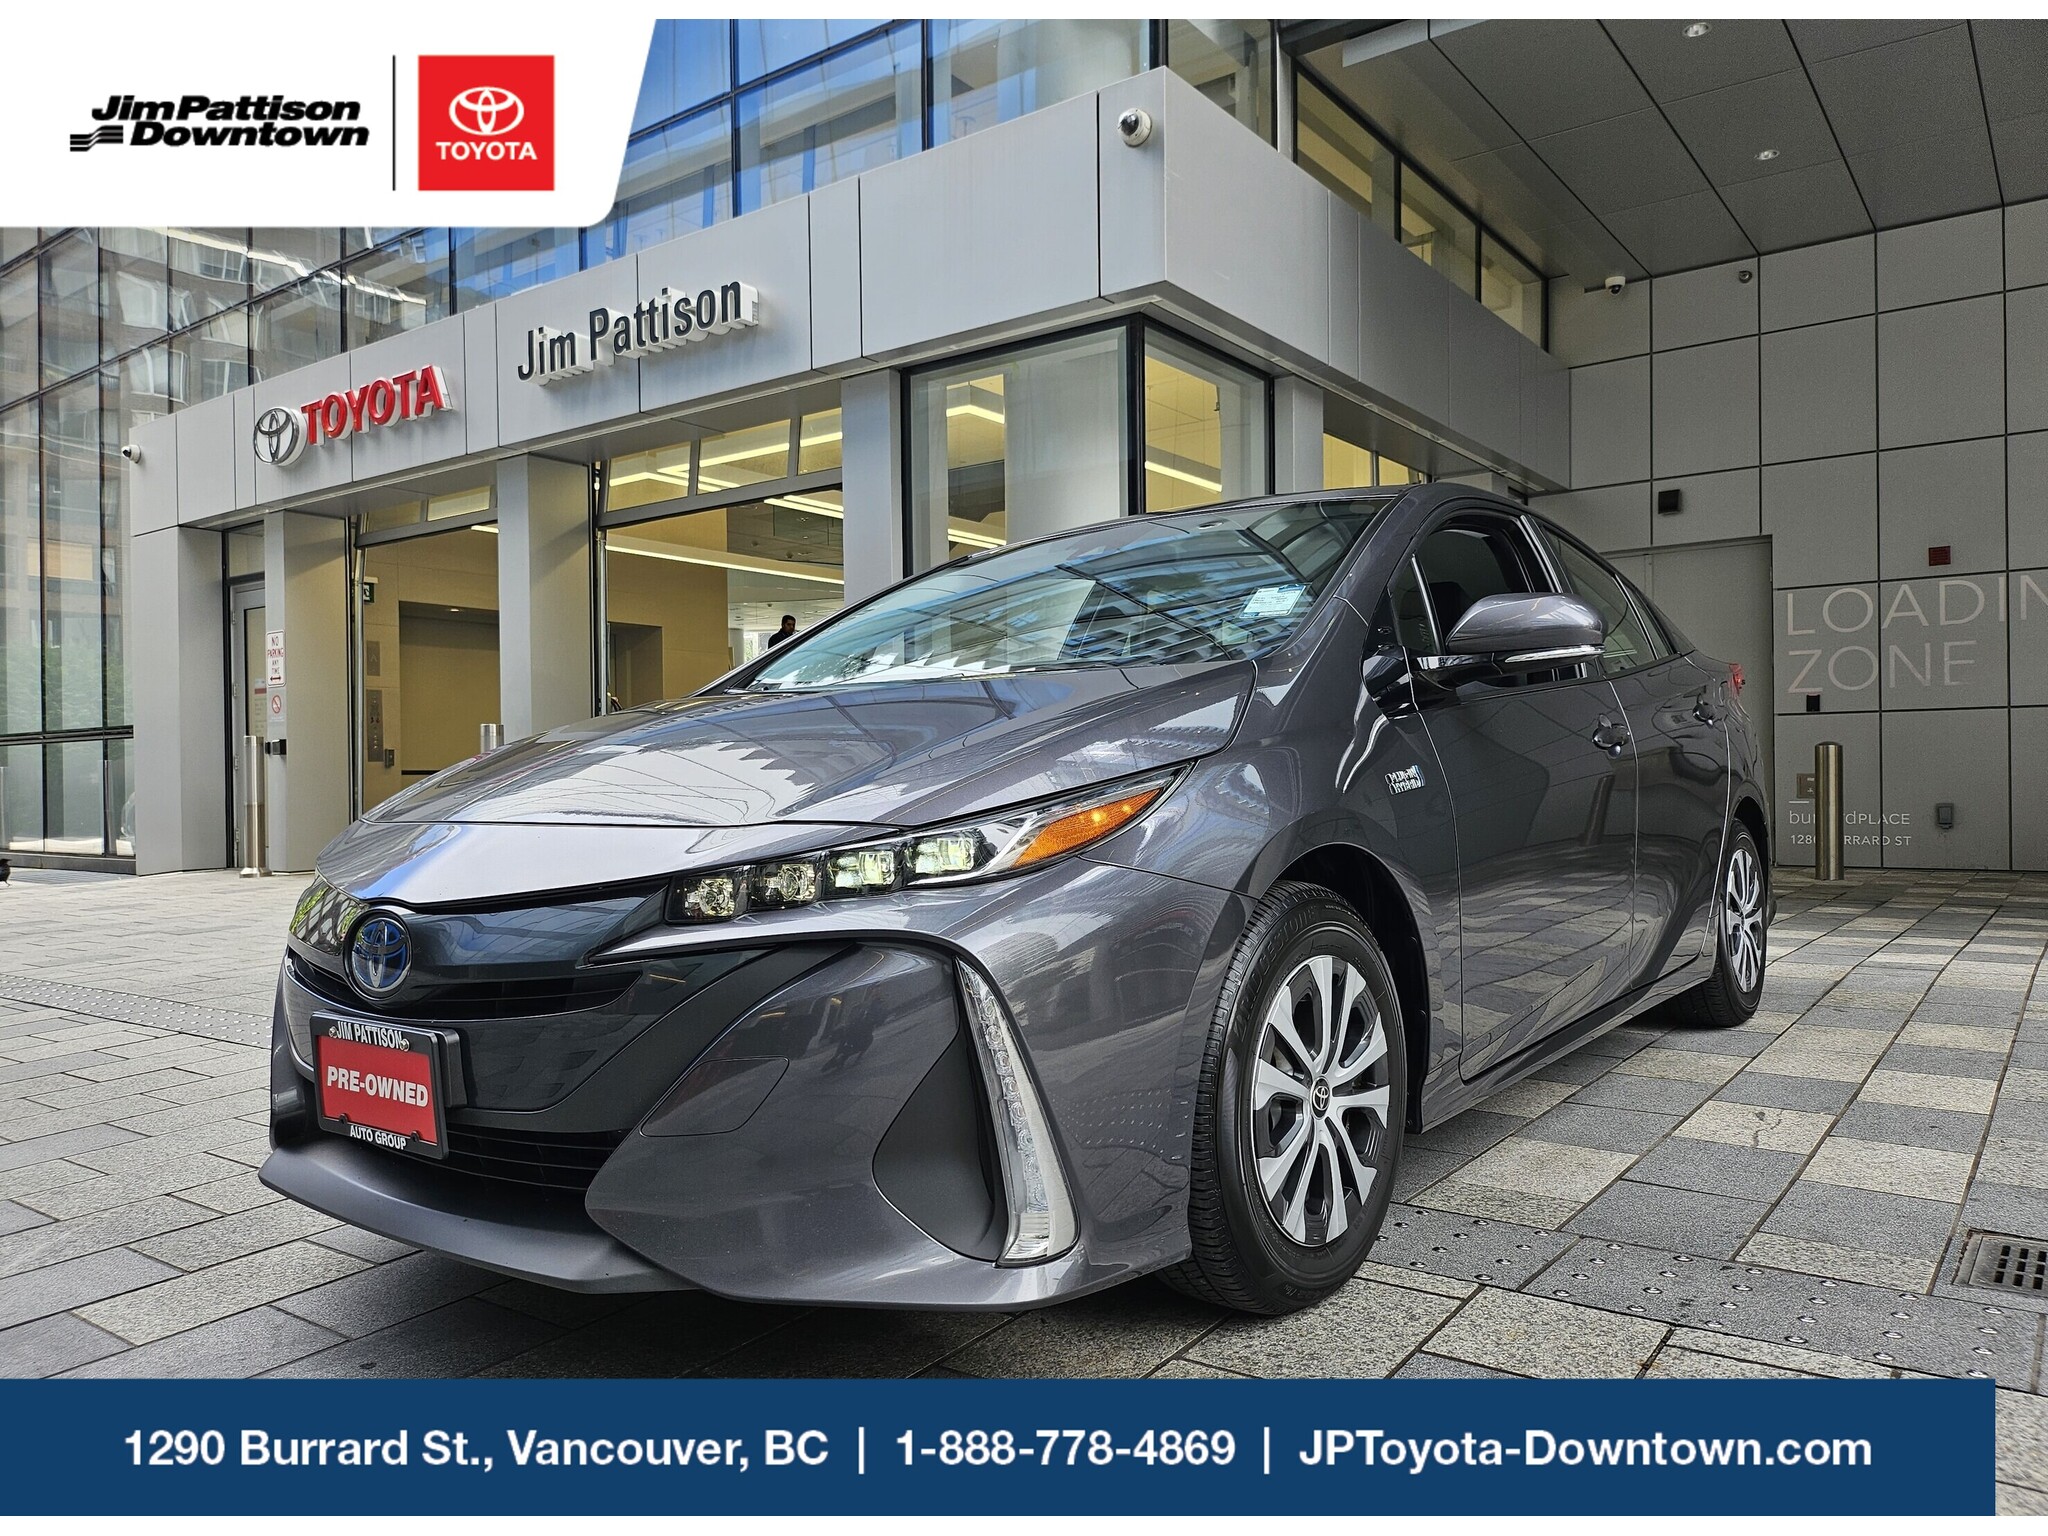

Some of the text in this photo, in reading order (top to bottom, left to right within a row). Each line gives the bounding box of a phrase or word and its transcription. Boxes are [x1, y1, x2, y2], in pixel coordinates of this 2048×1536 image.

[517, 281, 746, 384] Jim Pattison
[301, 364, 446, 446] TOYOTA
[267, 648, 284, 658] PARKING
[271, 636, 280, 647] NO
[1787, 640, 1977, 694] ZONE
[1843, 835, 1891, 846] RRARD
[1894, 835, 1912, 846] ST
[336, 1021, 402, 1050] JIM PATTISON
[326, 1065, 429, 1108] PRE-OWNED
[349, 1124, 407, 1151] AUTO GROUP
